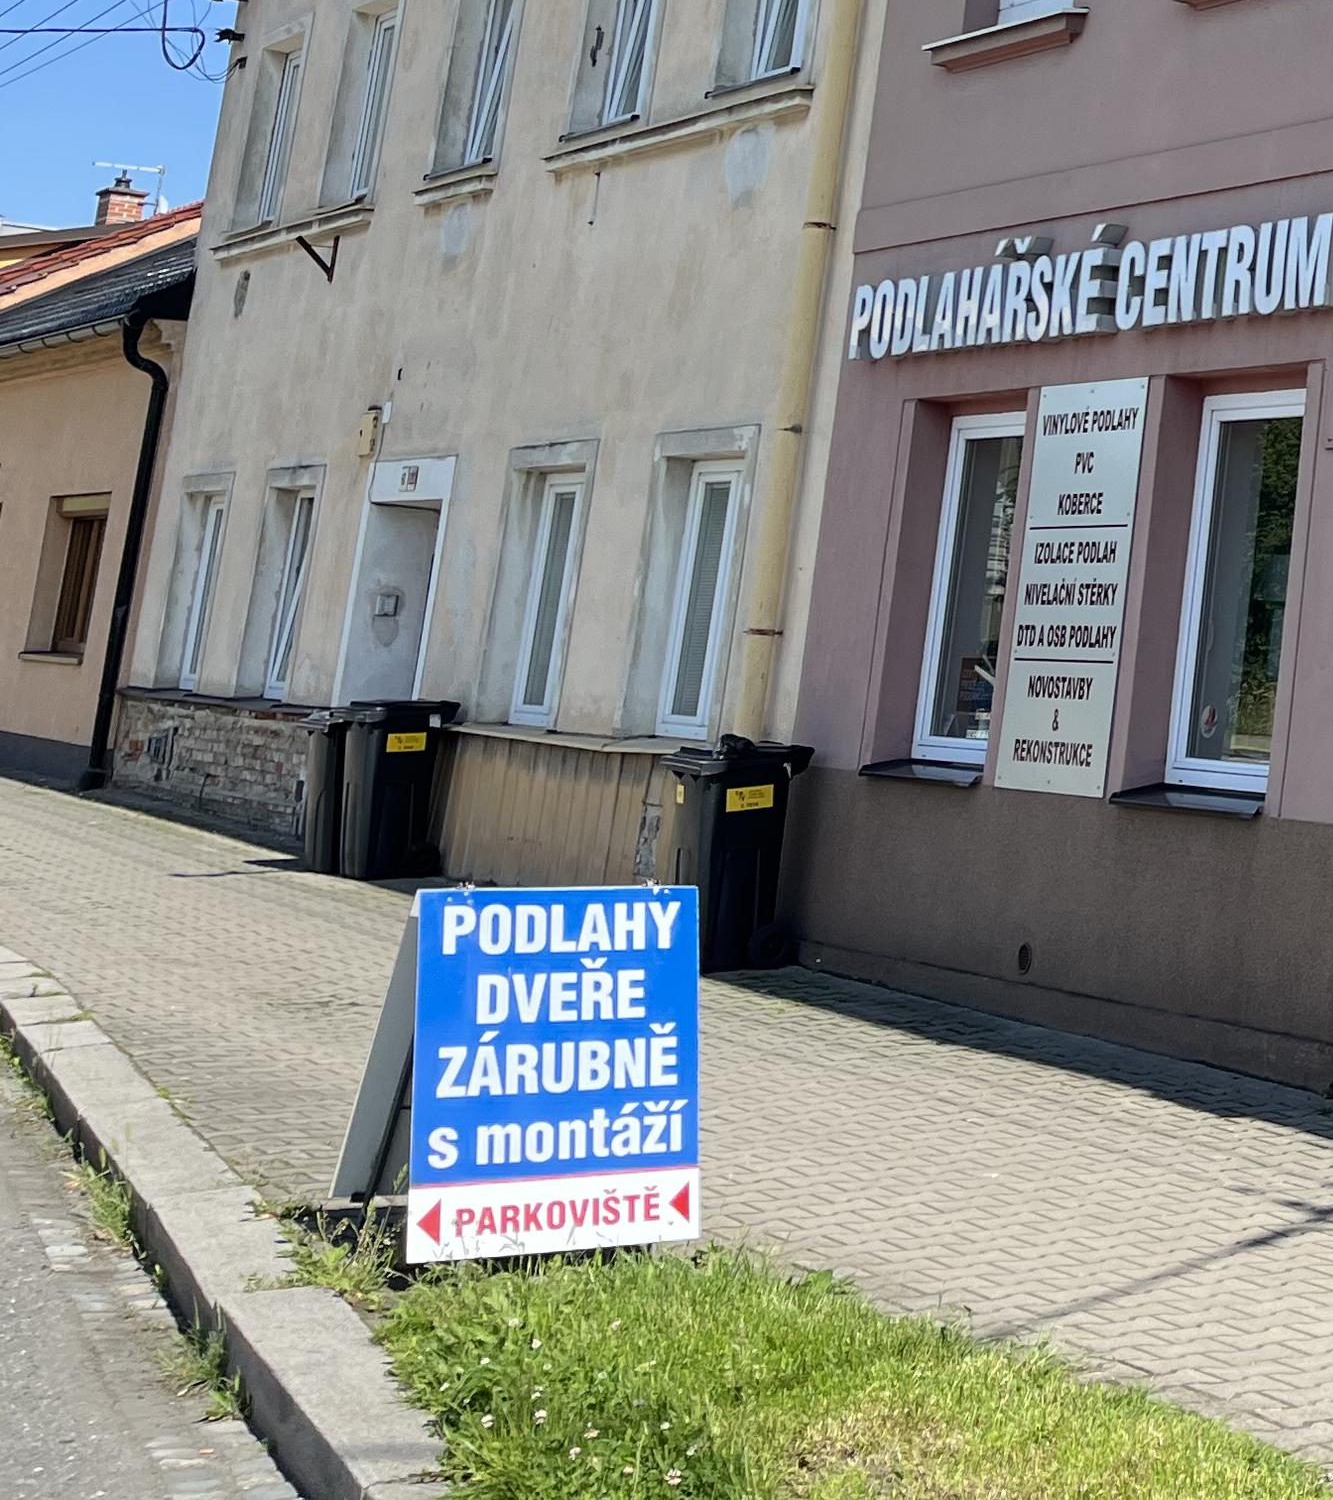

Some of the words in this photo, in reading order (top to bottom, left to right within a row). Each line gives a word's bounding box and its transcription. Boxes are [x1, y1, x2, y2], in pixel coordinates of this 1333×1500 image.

[849, 222, 1108, 360] PODLAHÁŘSKÉ
[1043, 406, 1090, 437] VINYLOVÉ
[1091, 407, 1140, 433] PODLAHY
[1074, 451, 1095, 475] PVC
[1057, 492, 1104, 516] KOBERCE
[1034, 541, 1075, 564] IZOLACE
[1076, 540, 1118, 564] PODLAH
[1024, 578, 1077, 606] NIVELAČNÍ
[1077, 578, 1119, 606] STĚRKY
[1017, 624, 1036, 647] DTD
[1037, 624, 1045, 647] A
[1047, 624, 1067, 648] OSB
[1068, 625, 1117, 649] PODLAHY
[1028, 675, 1093, 700] NOVOSTAVBY
[1052, 708, 1059, 732] &
[1013, 738, 1093, 767] REKONSTRUKCE
[442, 901, 682, 955] PODLAHY
[476, 957, 646, 1025] DVEŘE
[436, 1022, 678, 1099] ZÁRUBNĚ
[427, 1126, 459, 1169] s
[475, 1098, 689, 1166] montáží
[455, 1185, 661, 1238] PARKOVIŠTĚ
